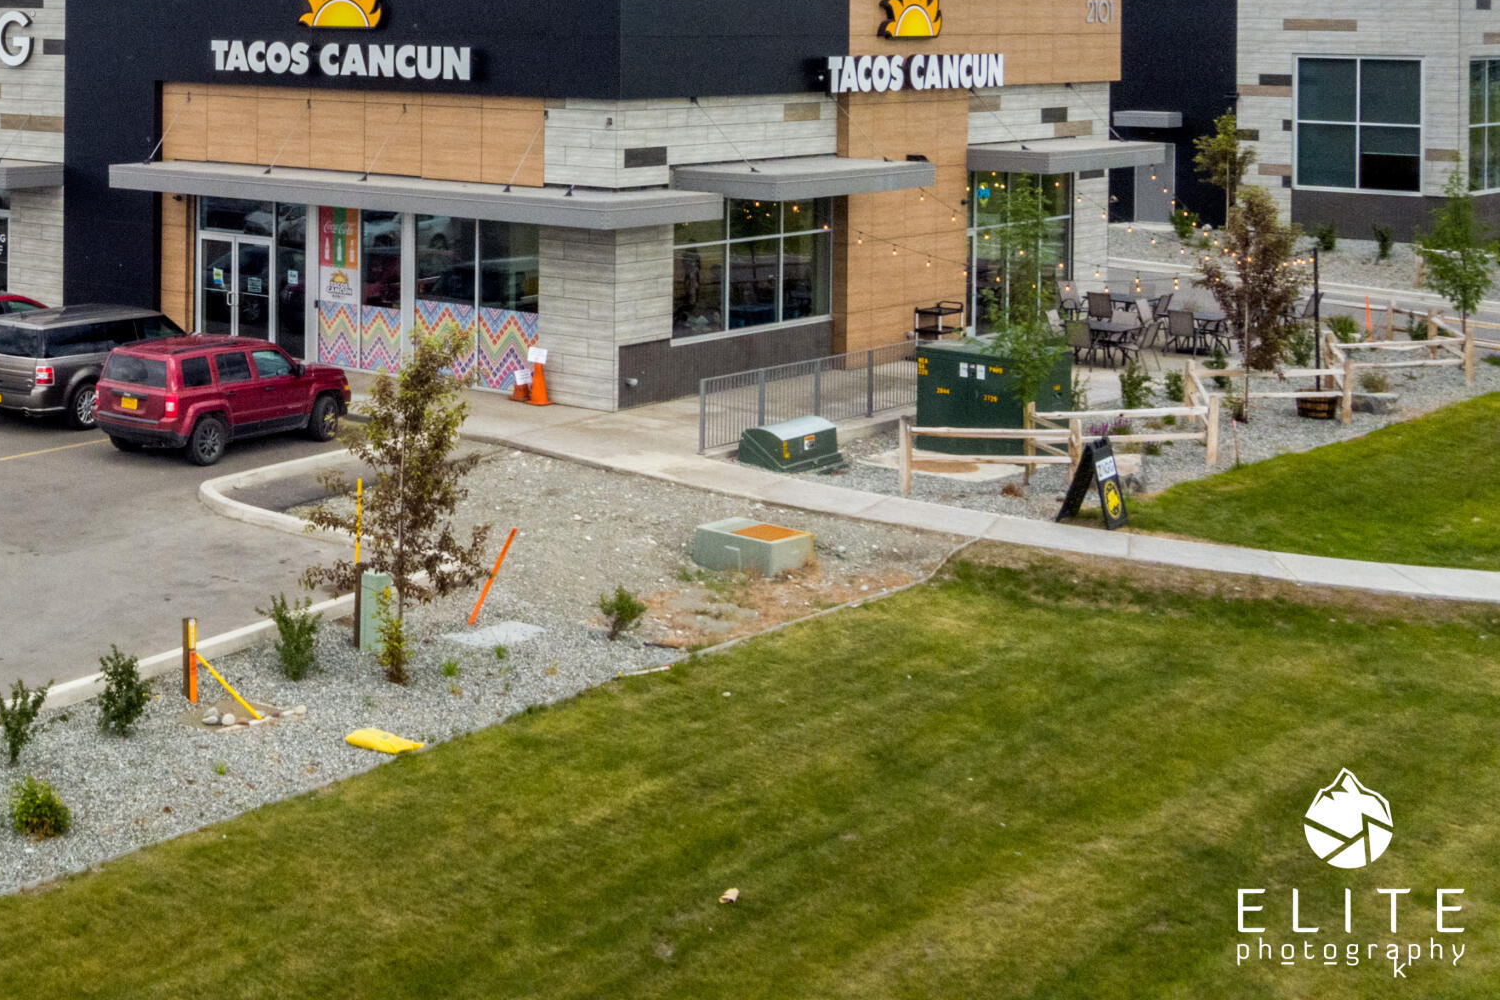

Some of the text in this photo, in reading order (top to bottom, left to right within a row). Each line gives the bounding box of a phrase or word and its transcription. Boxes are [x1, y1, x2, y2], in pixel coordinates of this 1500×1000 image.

[1086, 0, 1114, 23] 2101
[211, 39, 472, 81] TACOS CANCUN
[828, 53, 1005, 94] TACOS CANCUN
